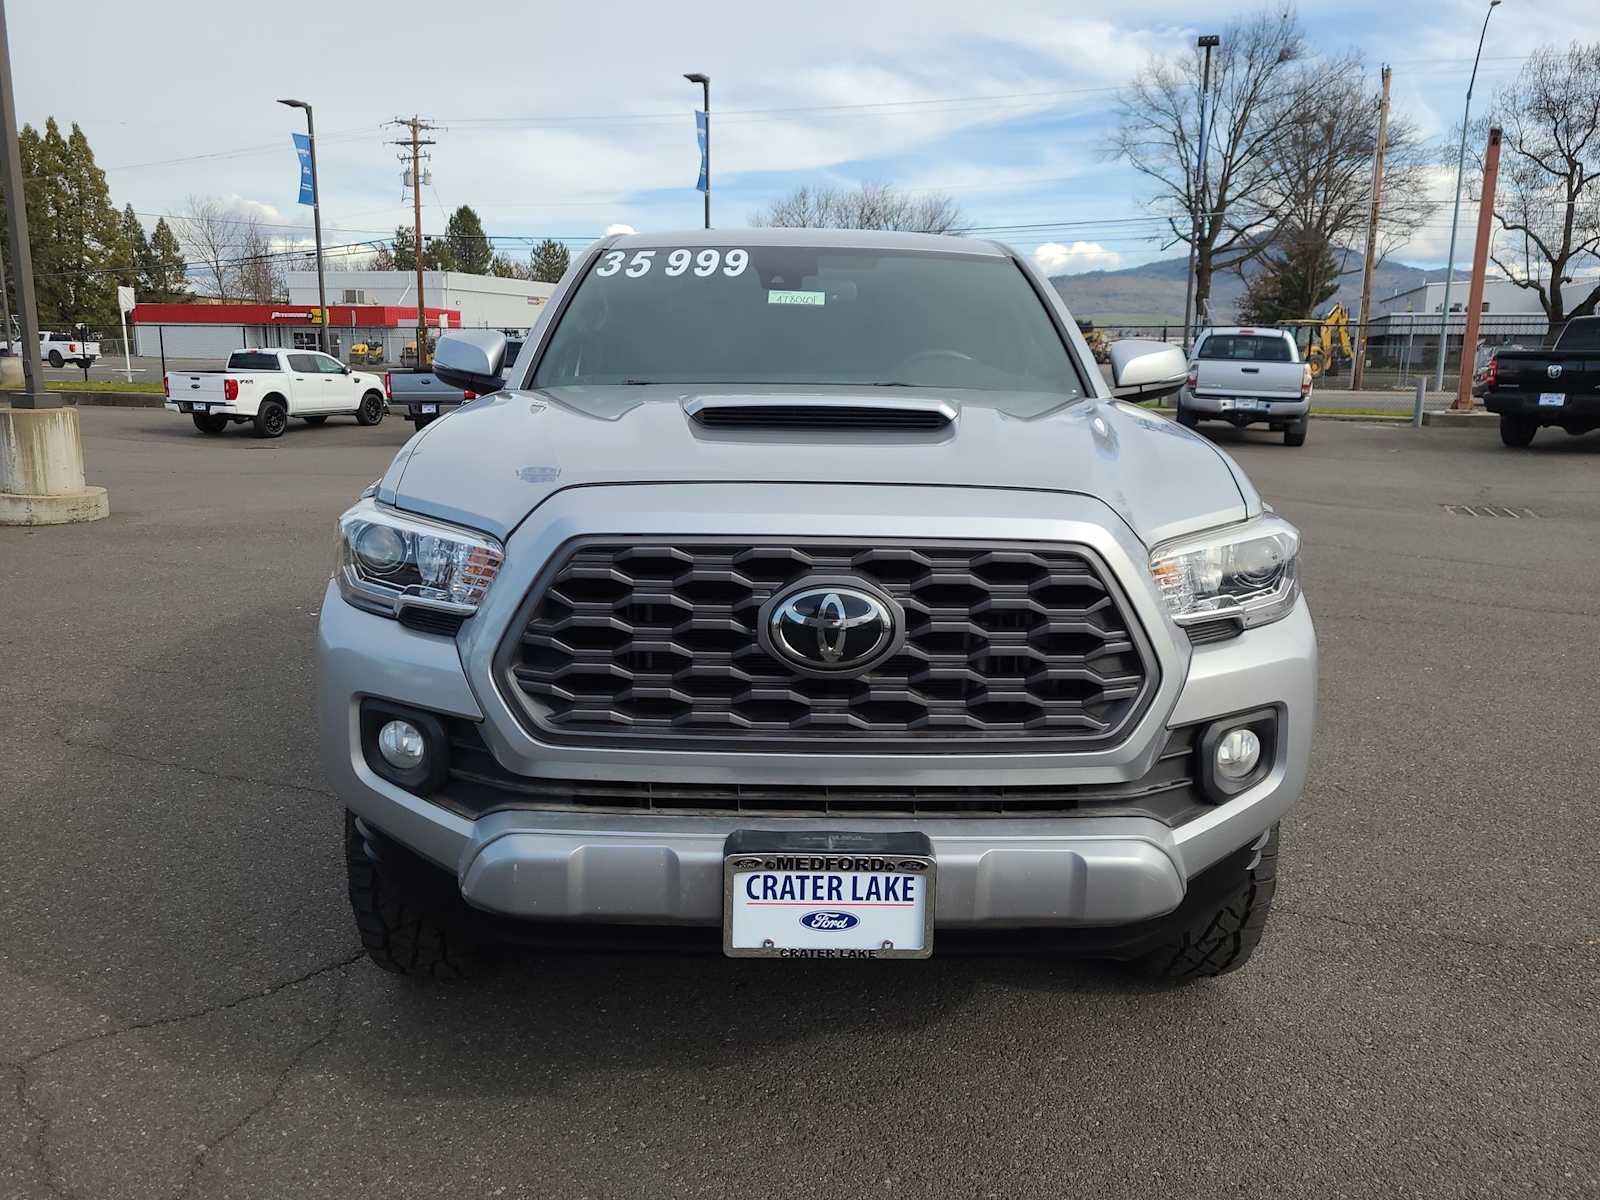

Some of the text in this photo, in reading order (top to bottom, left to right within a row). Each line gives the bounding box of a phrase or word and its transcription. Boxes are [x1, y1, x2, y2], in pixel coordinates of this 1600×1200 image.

[596, 249, 749, 278] 35 999
[777, 857, 884, 872] MEDFORD
[746, 874, 915, 902] CRATER LAKE
[811, 912, 848, 930] Ford
[780, 948, 877, 959] CRATER LAKE
